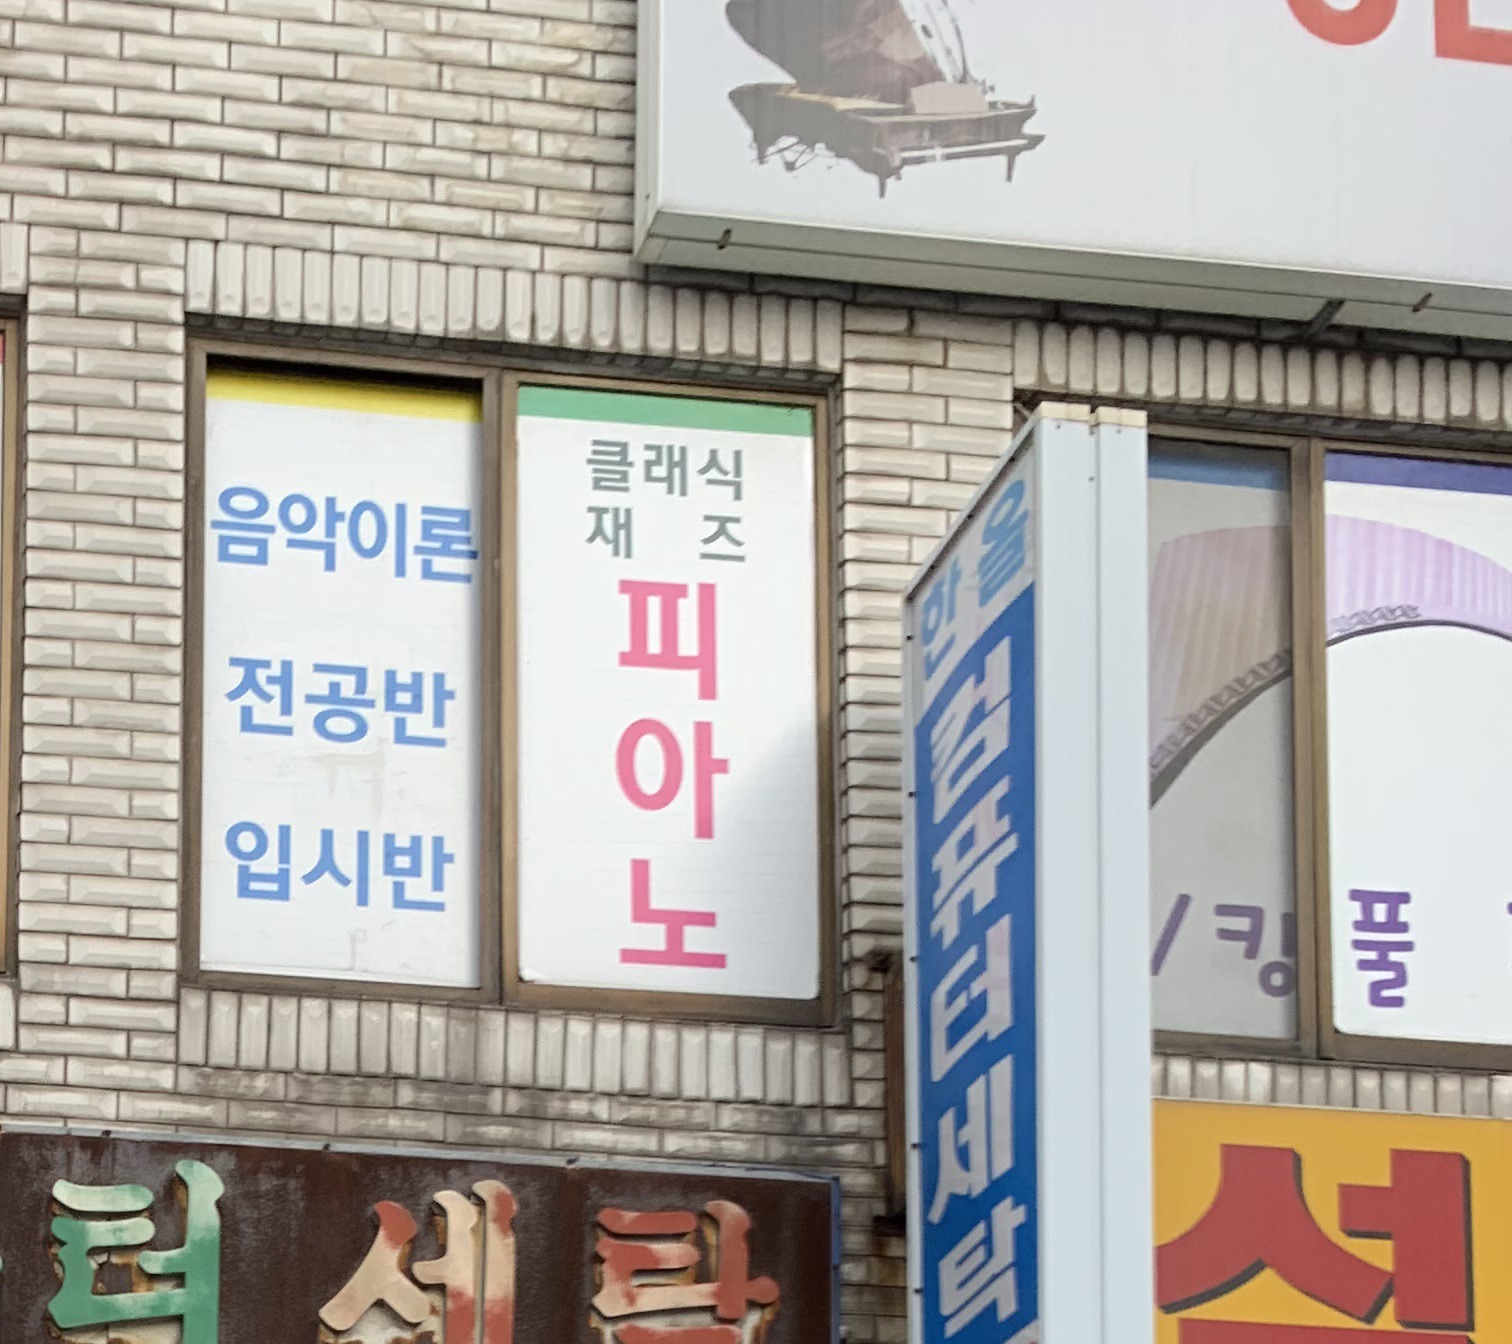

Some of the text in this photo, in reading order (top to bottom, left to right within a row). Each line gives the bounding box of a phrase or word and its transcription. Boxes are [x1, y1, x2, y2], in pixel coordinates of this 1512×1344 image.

[585, 439, 747, 501] 클래식
[210, 486, 480, 584] 음악이론
[225, 655, 456, 749] 전공반
[615, 578, 730, 970] 피아노
[224, 820, 456, 913] 입시반
